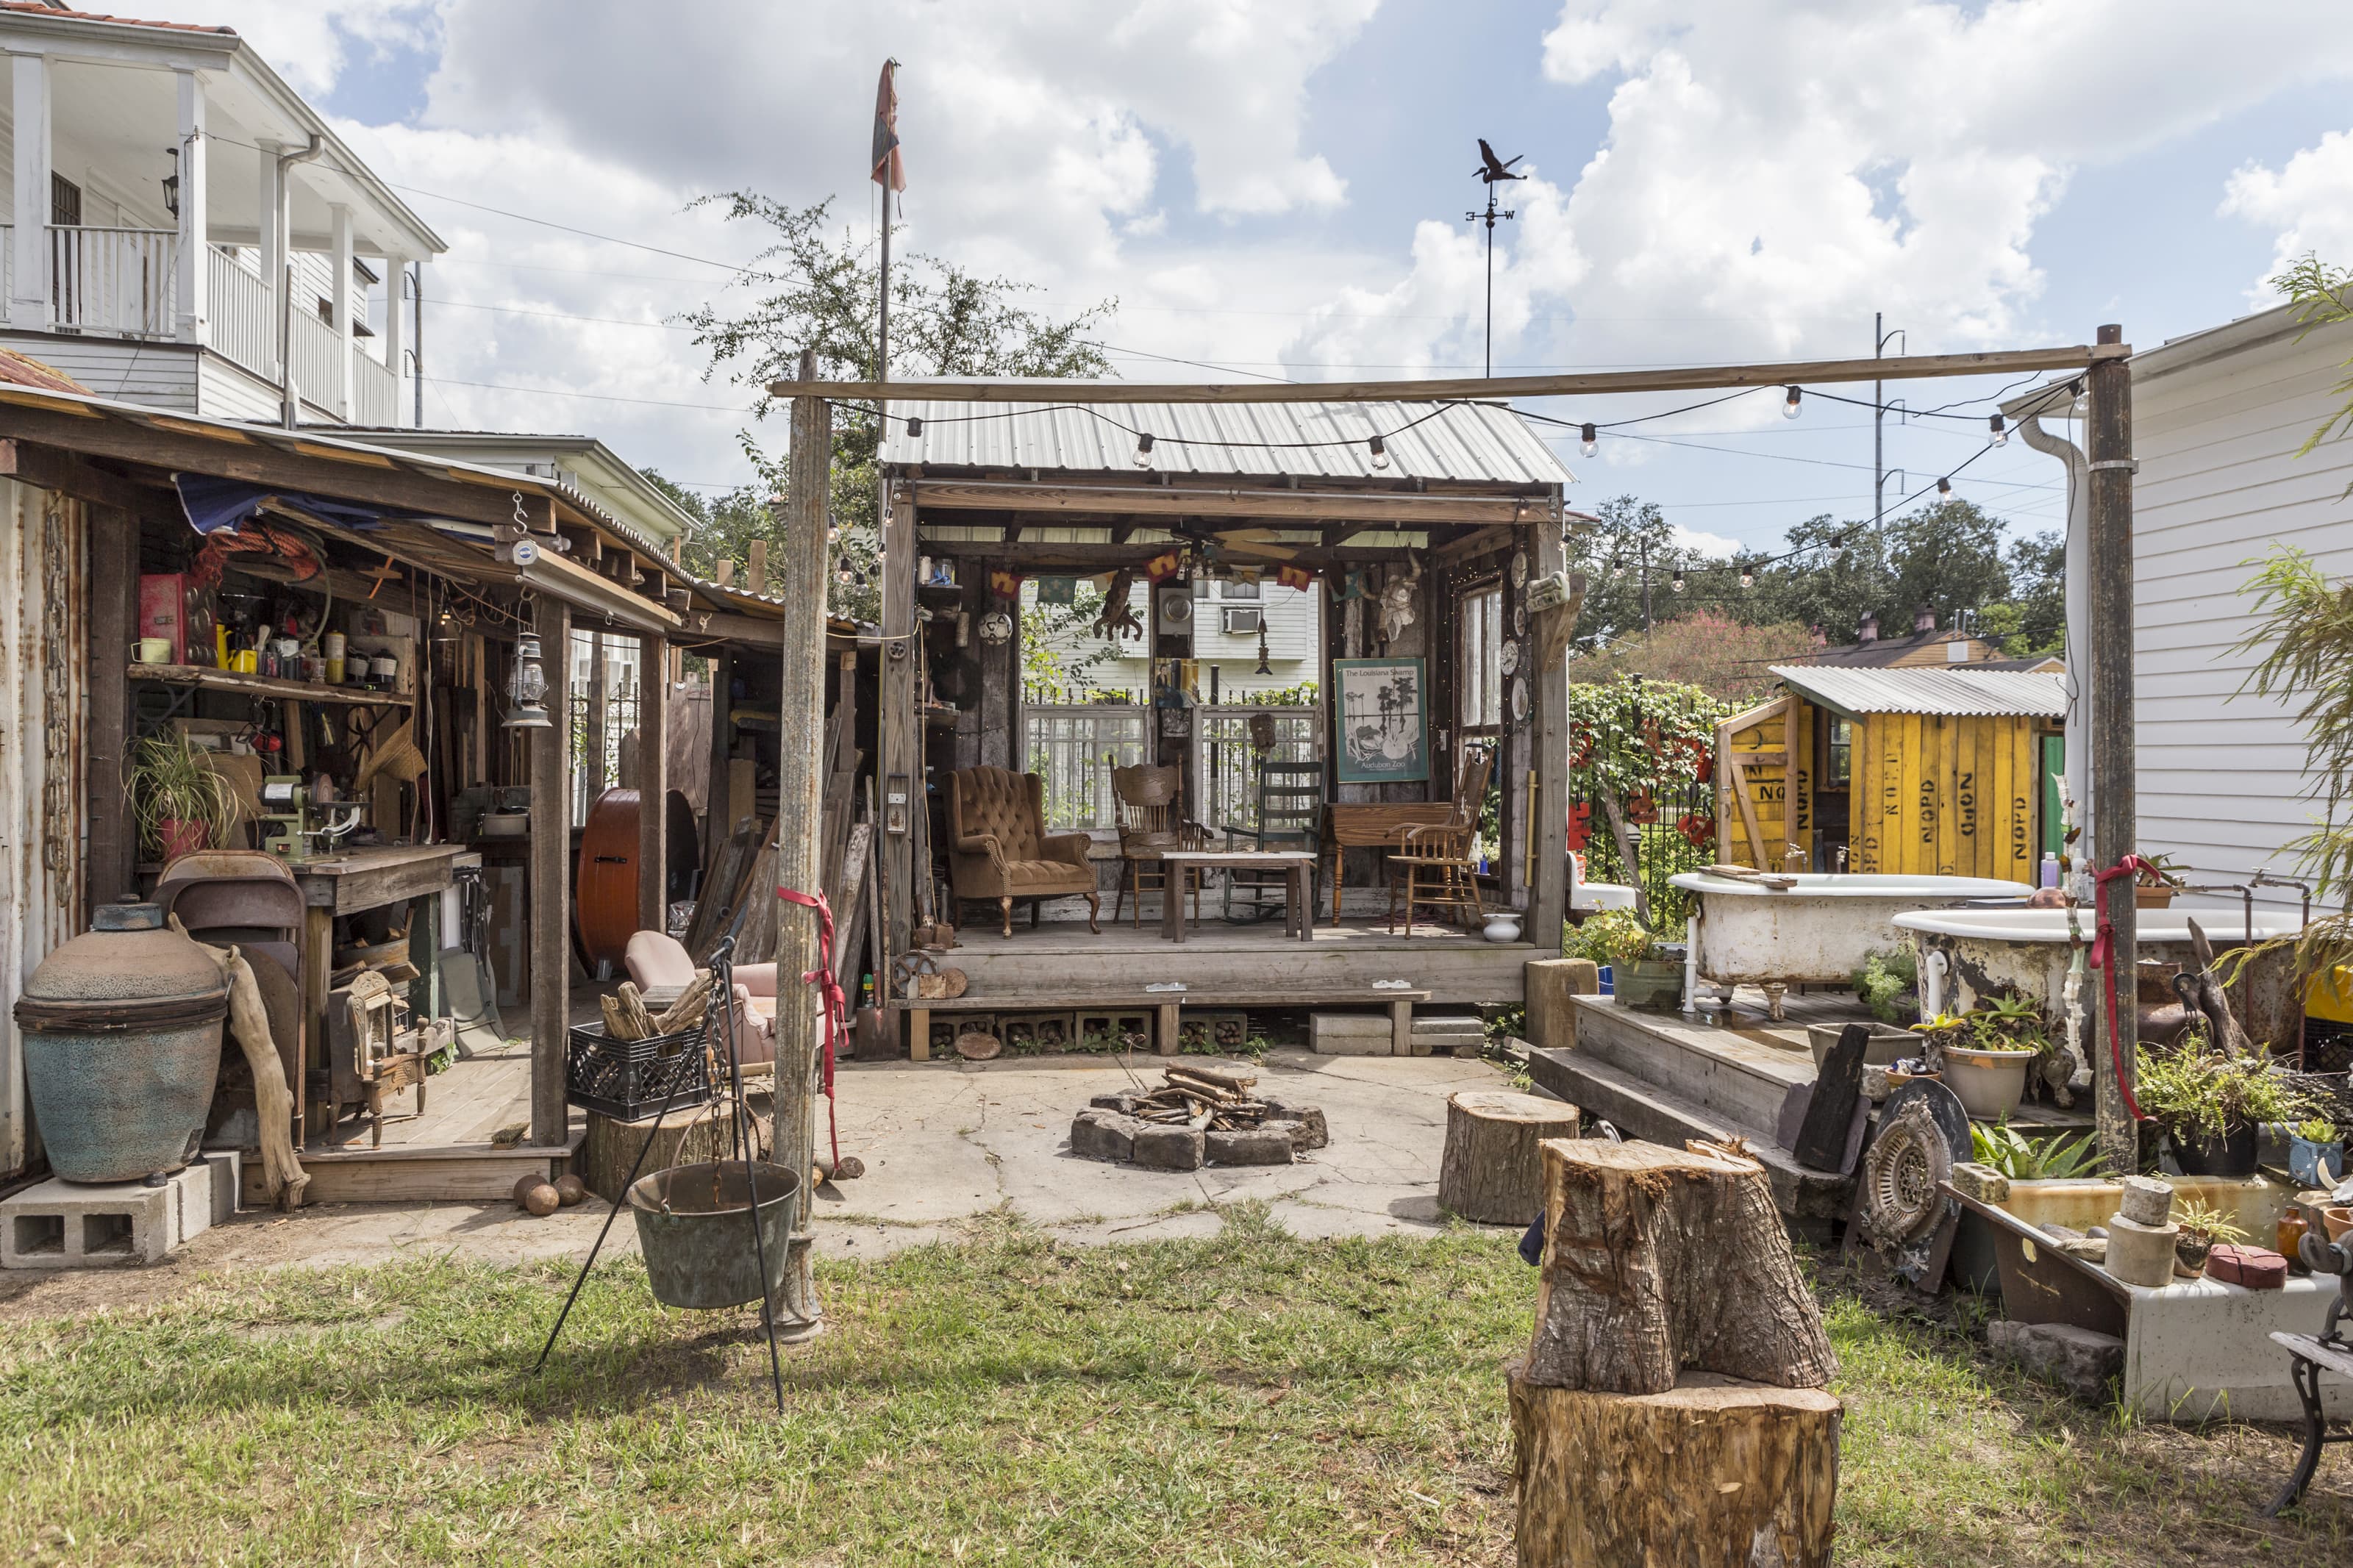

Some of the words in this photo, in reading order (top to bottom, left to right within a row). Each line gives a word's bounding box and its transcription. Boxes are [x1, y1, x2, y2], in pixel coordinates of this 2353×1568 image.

[1504, 210, 1515, 220] W
[1390, 669, 1414, 677] Swamp
[1361, 761, 1390, 769] Audubon
[1921, 780, 1935, 843] NOPD
[1960, 773, 1974, 837] NOPD
[2014, 797, 2027, 860] NOPD
